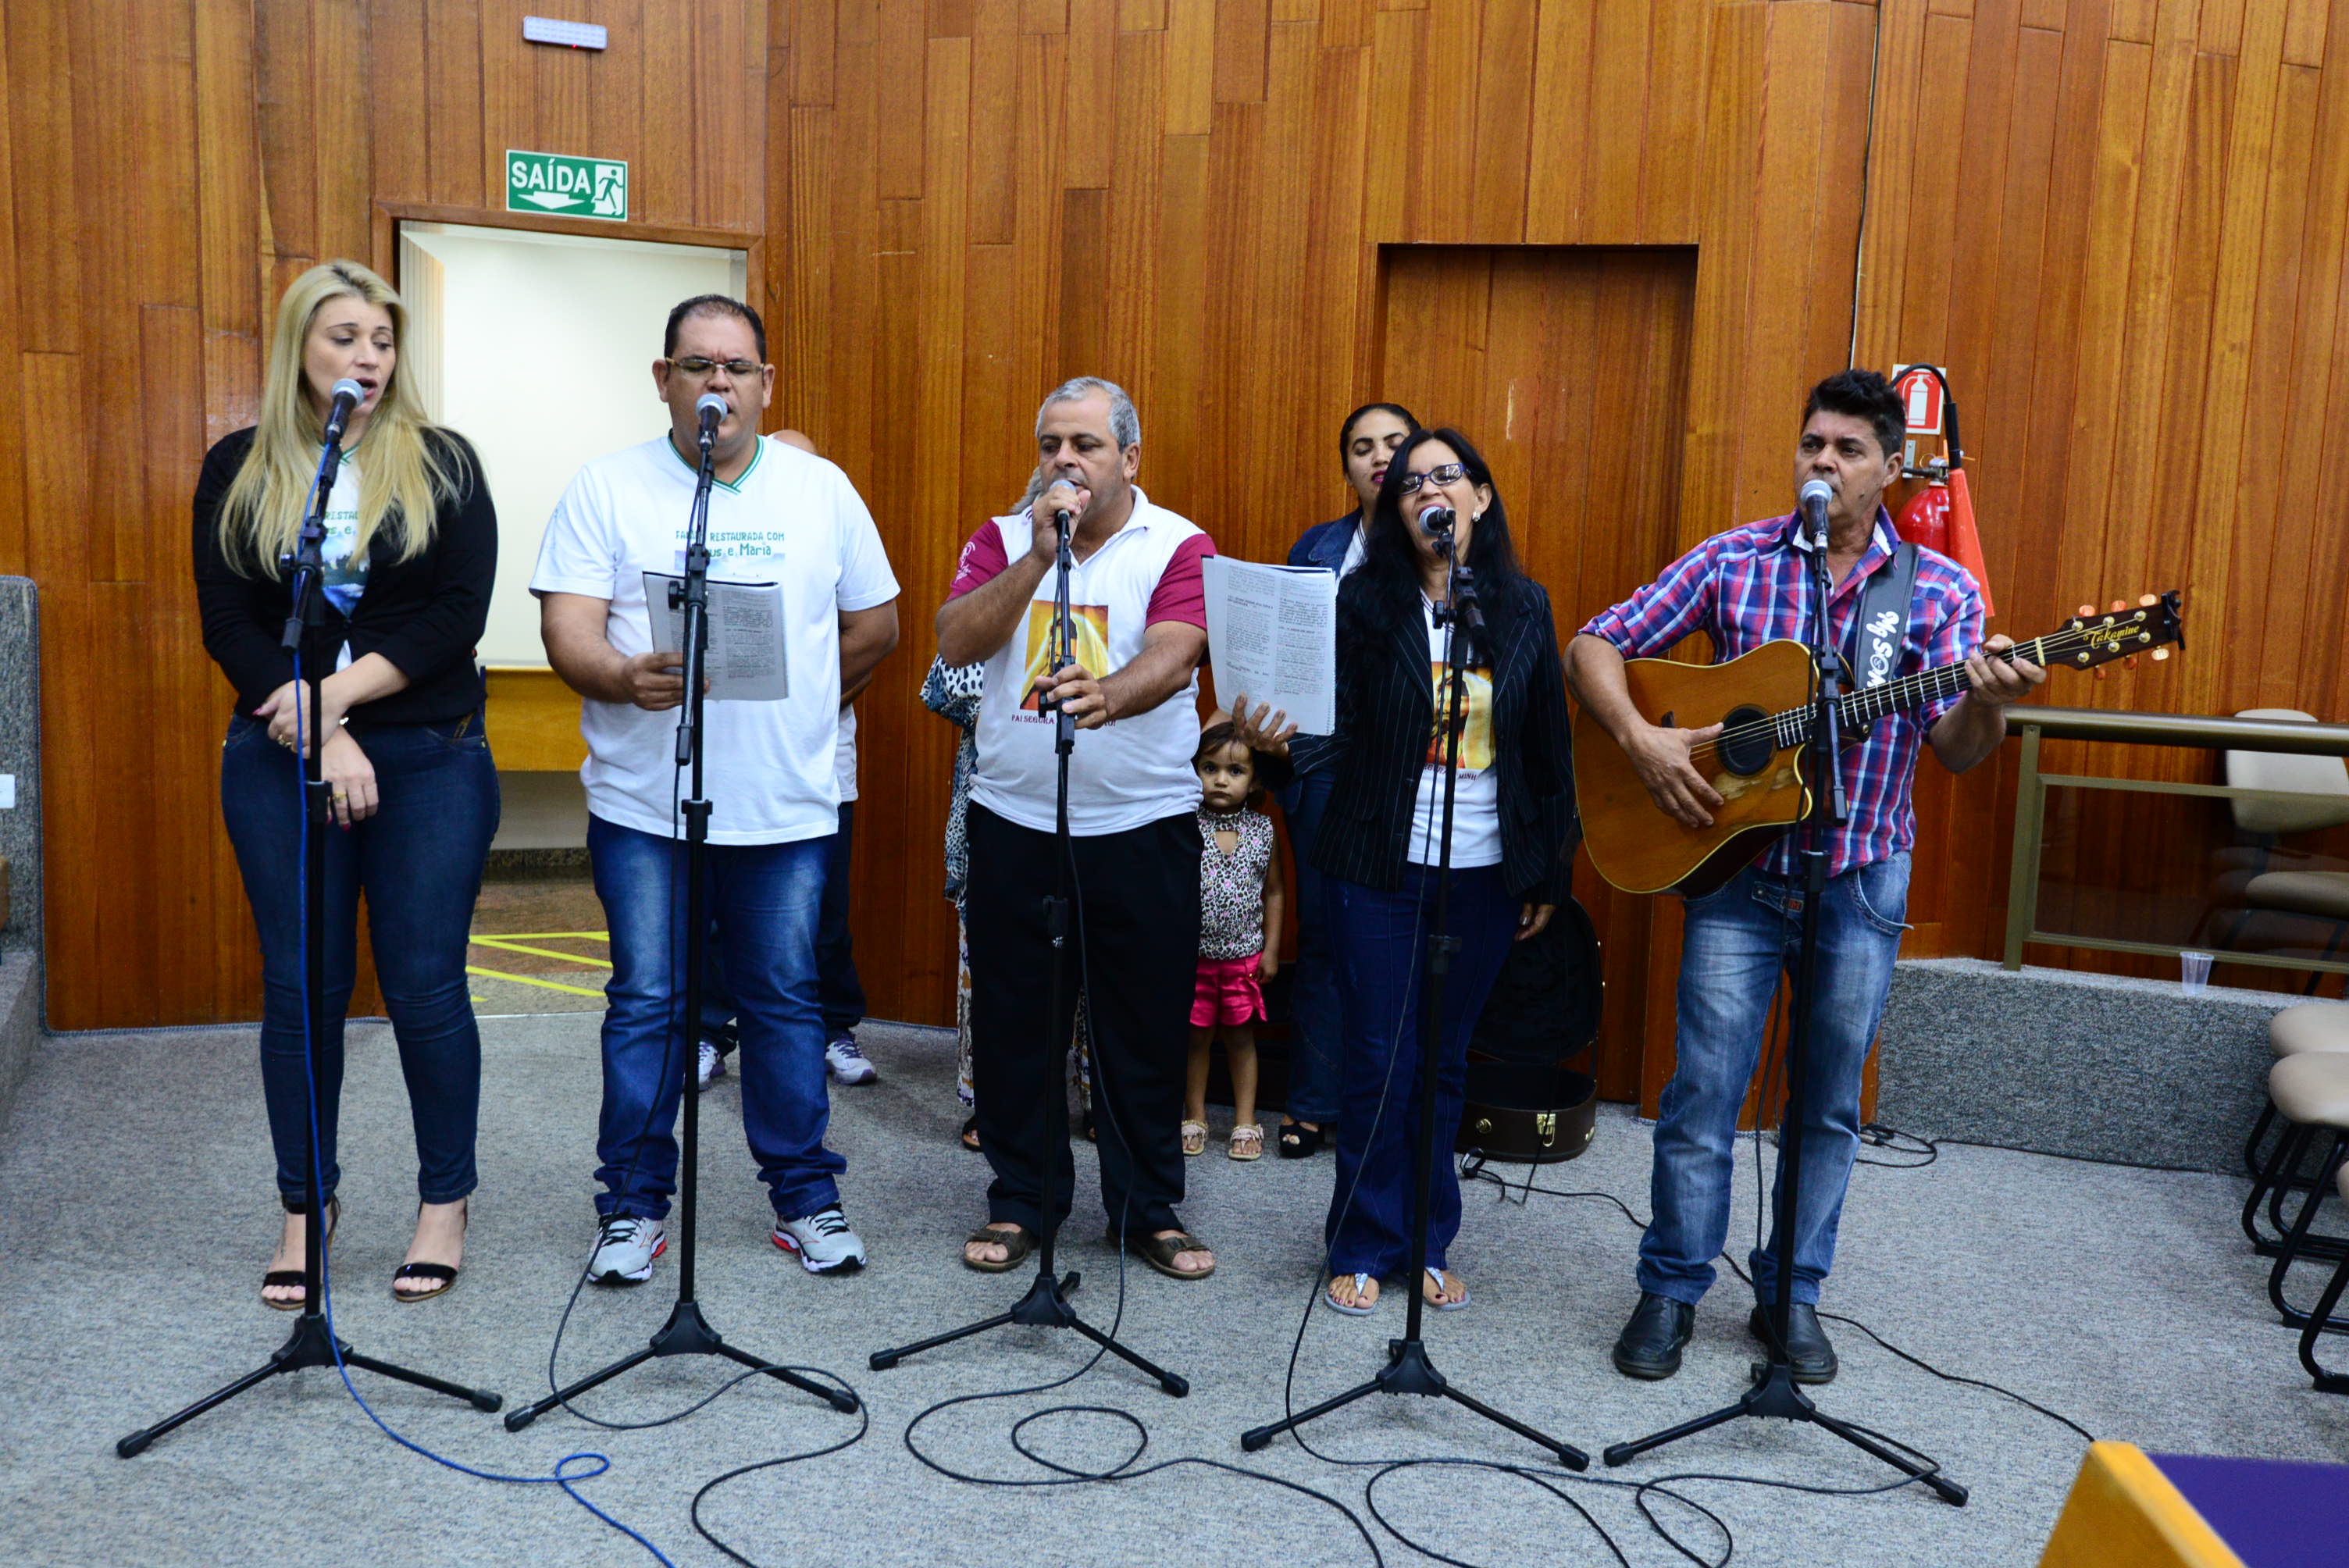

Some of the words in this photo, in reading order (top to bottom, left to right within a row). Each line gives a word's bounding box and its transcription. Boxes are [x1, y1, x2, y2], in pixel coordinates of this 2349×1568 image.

[512, 159, 591, 195] SAÍDA
[710, 531, 764, 542] RESTAURADA
[767, 531, 785, 541] COM
[727, 547, 734, 556] e
[740, 543, 772, 556] Maria
[2083, 625, 2140, 649] Takamine
[1011, 714, 1022, 722] PAI
[1024, 715, 1054, 725] SEGURA
